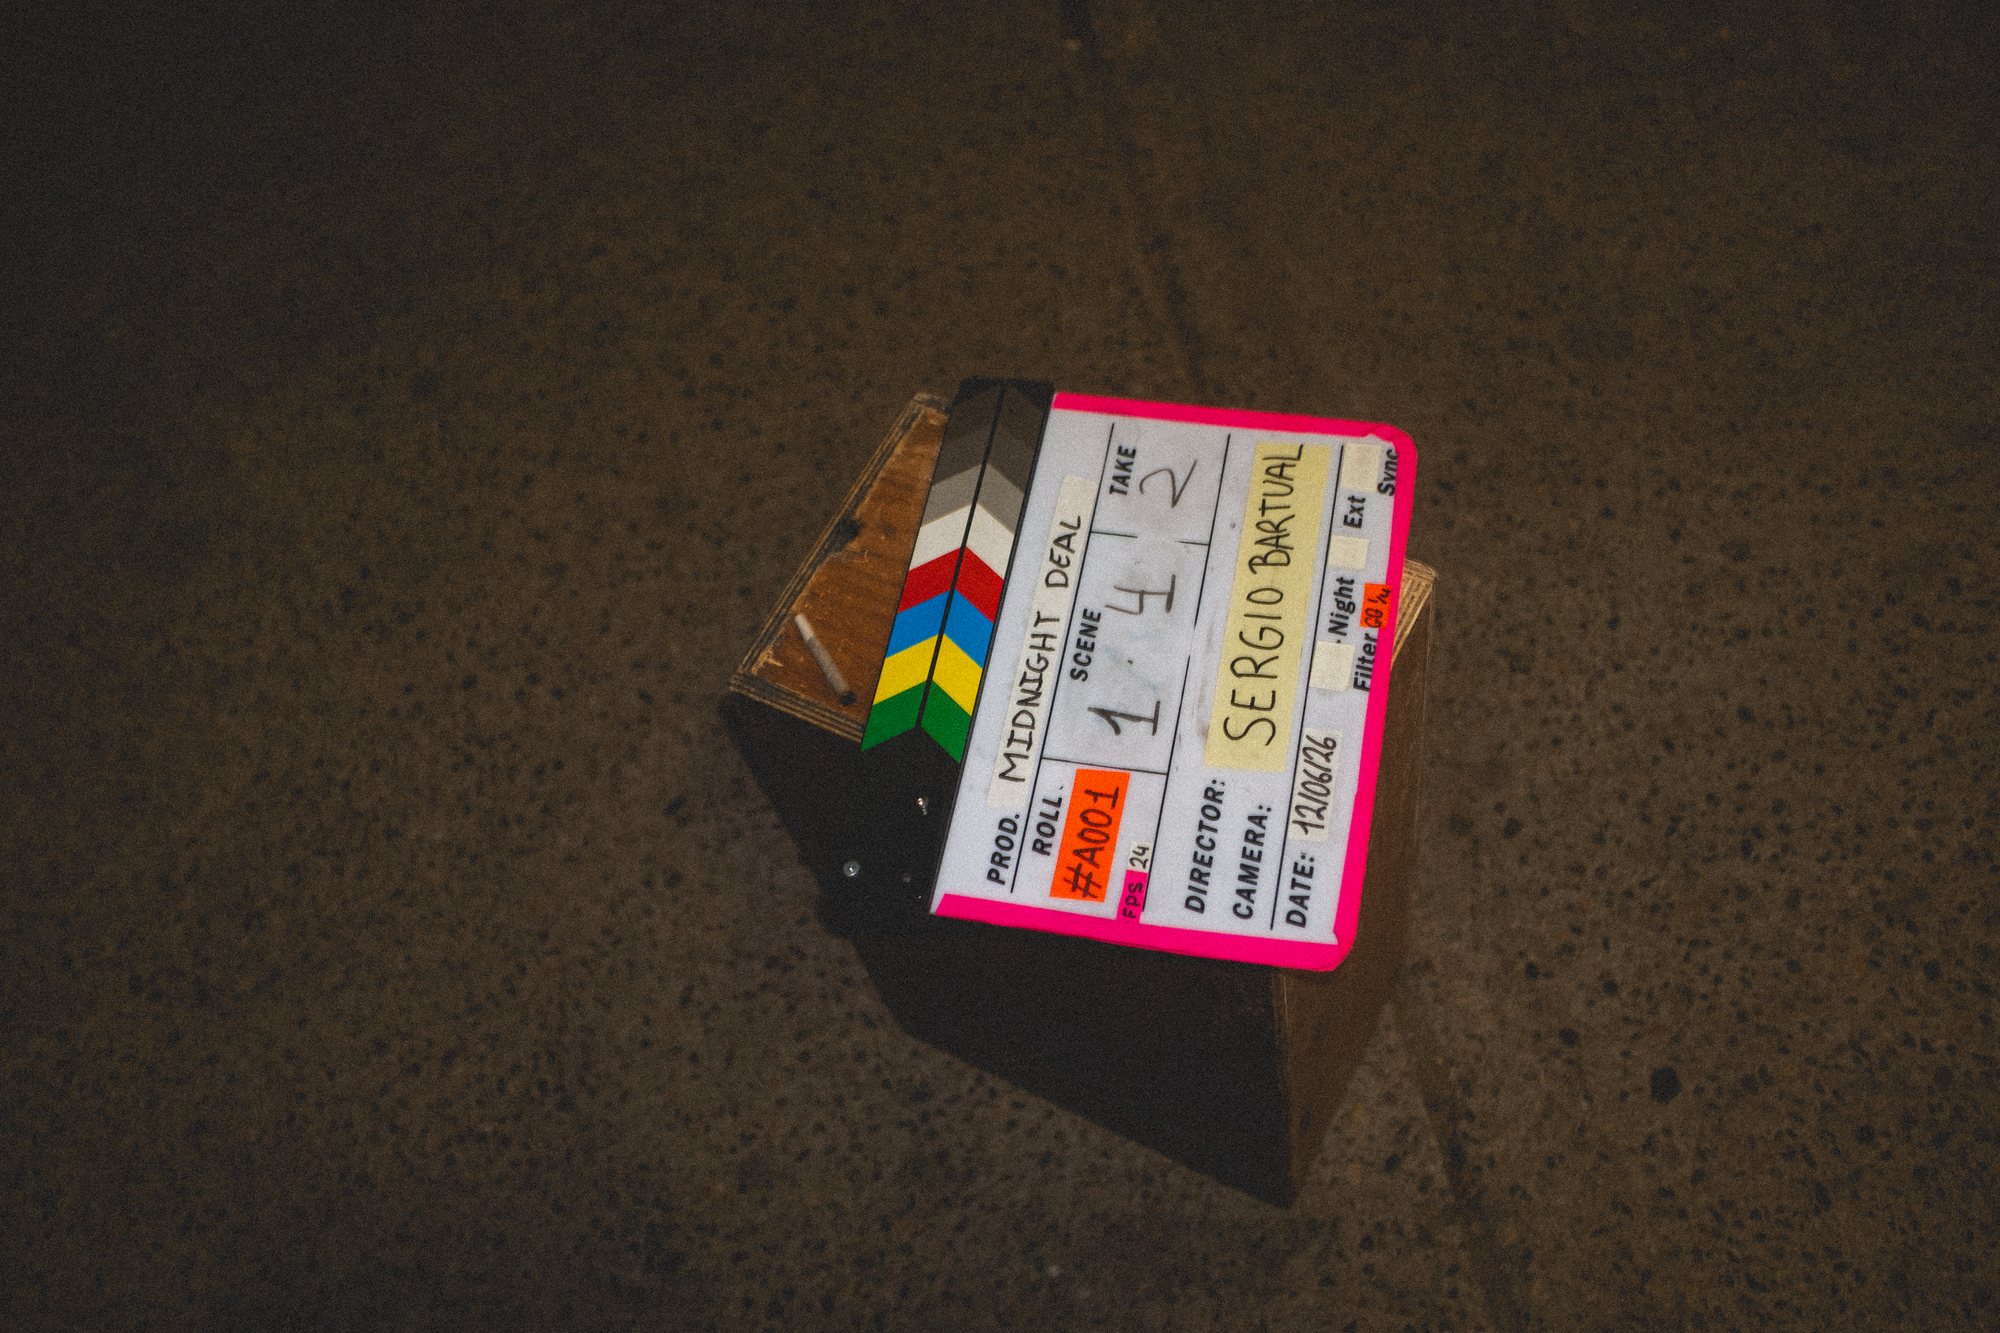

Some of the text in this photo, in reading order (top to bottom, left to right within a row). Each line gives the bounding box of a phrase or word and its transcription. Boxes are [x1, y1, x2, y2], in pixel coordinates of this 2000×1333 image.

[1109, 445, 1136, 496] TAKE
[1139, 459, 1198, 509] 2
[1343, 495, 1366, 529] Ext
[1222, 444, 1304, 746] SERGIO BARTUAL
[1328, 577, 1356, 636] Night
[998, 516, 1081, 782] MIDNIGHT DEAL
[1070, 608, 1101, 682] SCENE
[1088, 574, 1176, 736] 1 4
[1353, 632, 1379, 692] Filter
[1291, 734, 1337, 835] 12/06/26
[987, 813, 1020, 885] PROD.
[1063, 787, 1120, 898] #A001
[1184, 779, 1226, 914] DIRECTOR:
[1232, 805, 1272, 919] CAMERA:
[1122, 846, 1149, 919] FPS 24
[1285, 853, 1315, 928] DATE:
